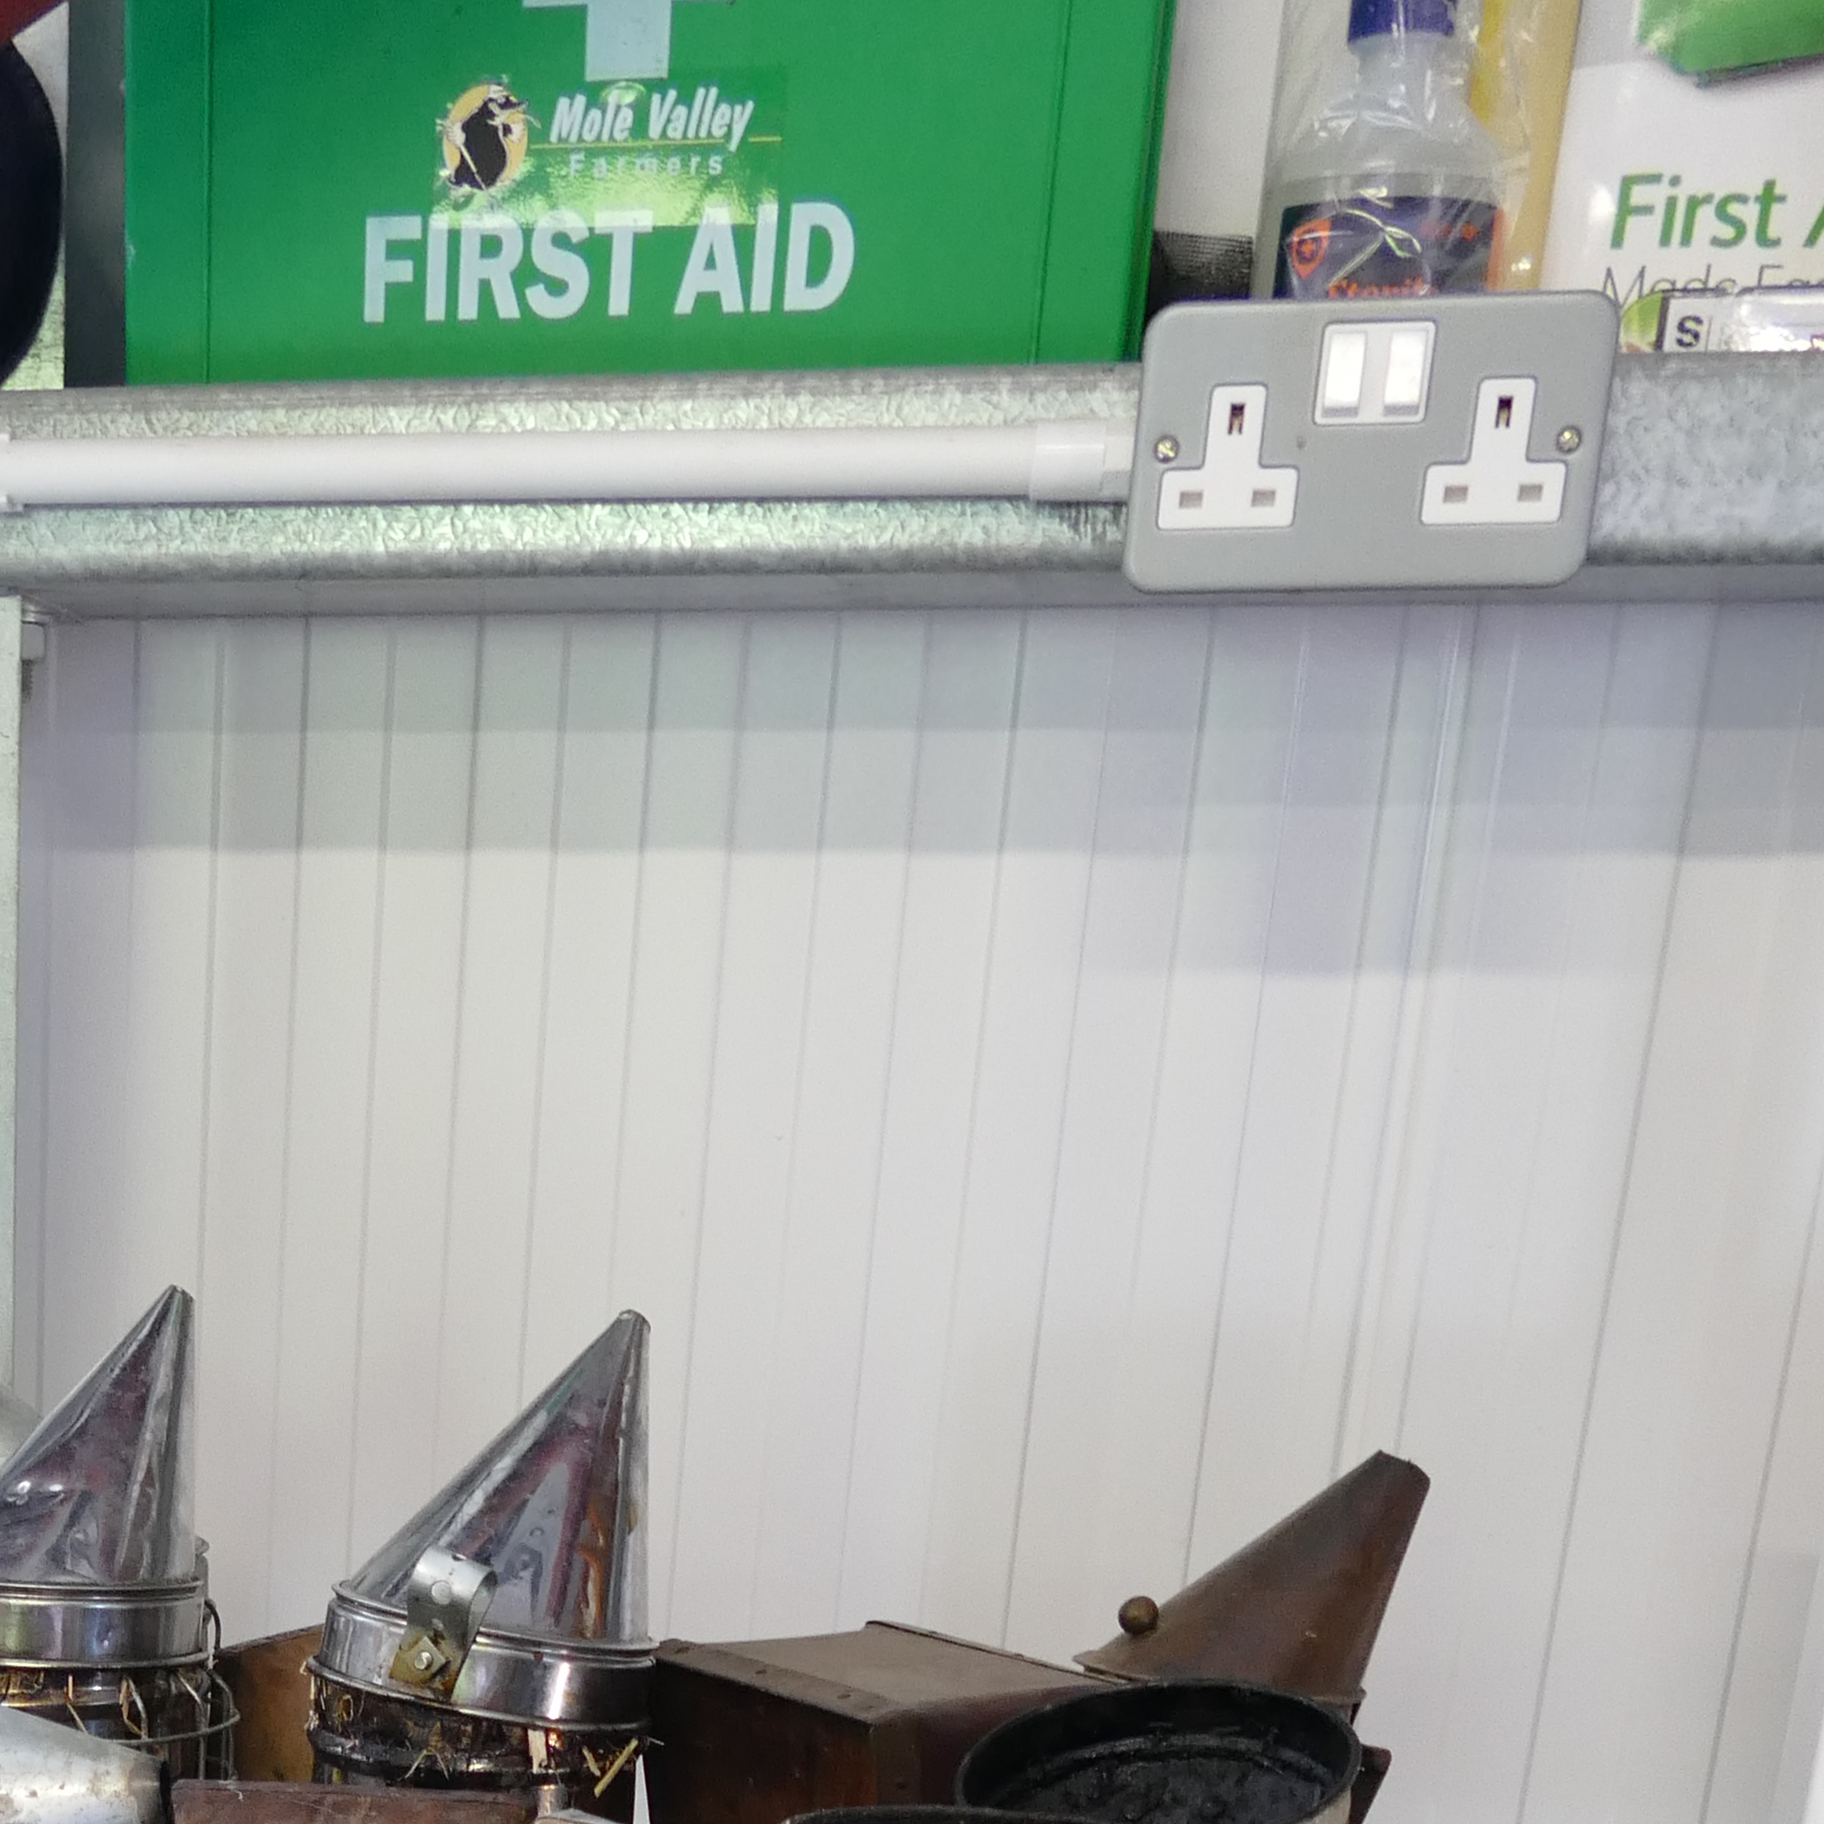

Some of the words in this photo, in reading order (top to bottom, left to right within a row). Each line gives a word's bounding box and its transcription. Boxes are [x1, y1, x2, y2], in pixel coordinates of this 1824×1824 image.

[549, 87, 633, 144] Mole
[649, 85, 754, 152] Valley
[569, 152, 722, 180] Farmers
[1610, 172, 1787, 250] First
[363, 209, 654, 323] FIRST
[673, 199, 855, 315] AID
